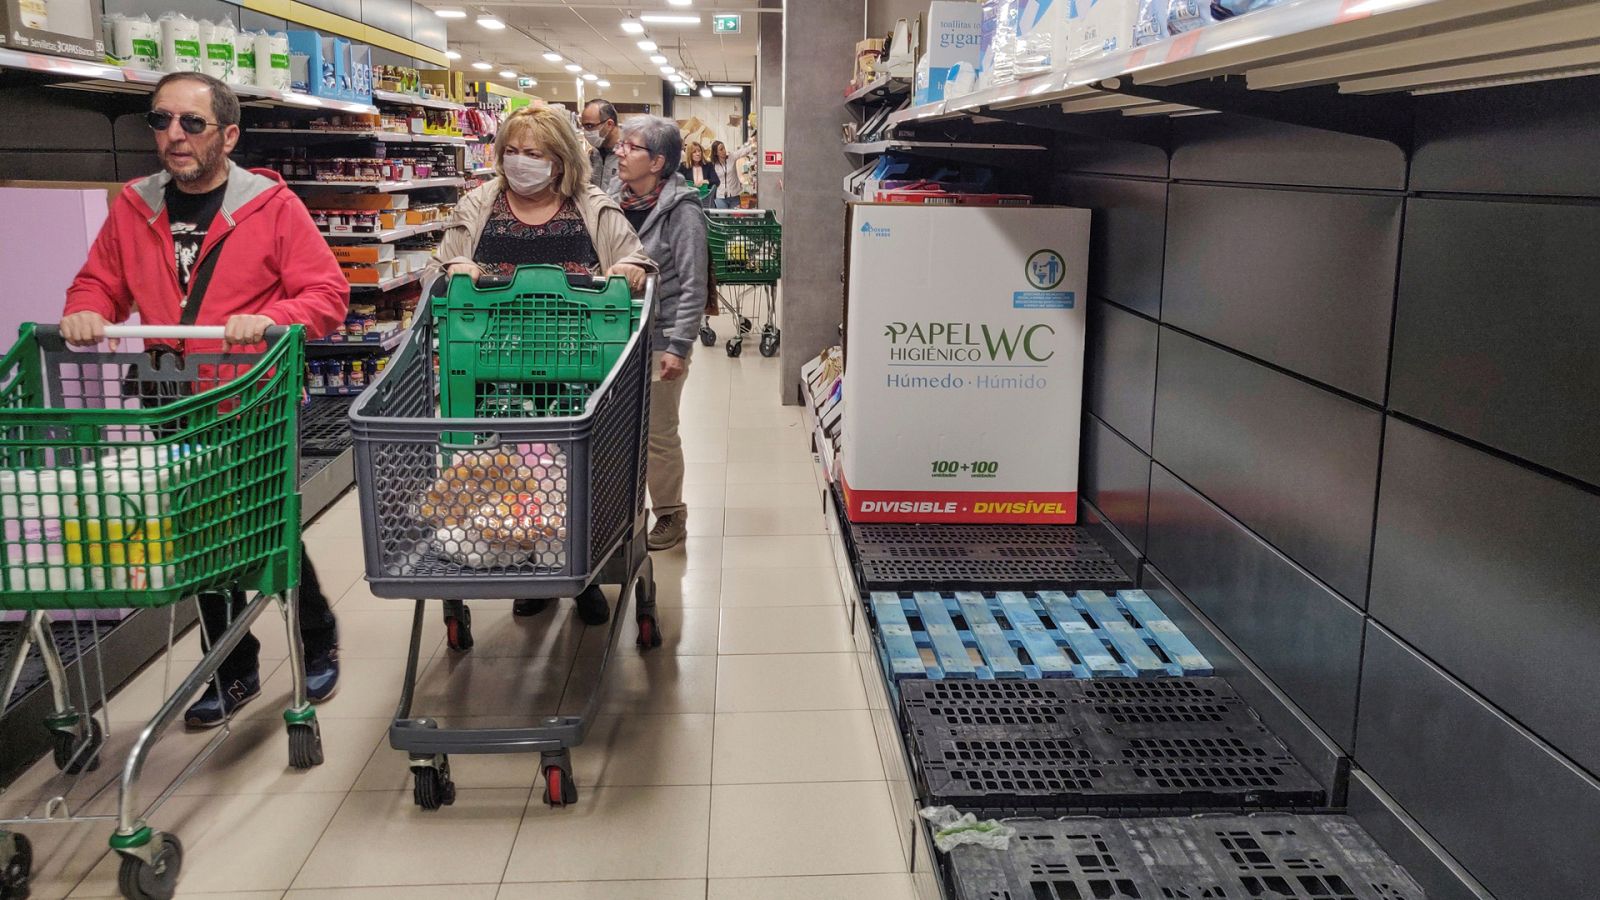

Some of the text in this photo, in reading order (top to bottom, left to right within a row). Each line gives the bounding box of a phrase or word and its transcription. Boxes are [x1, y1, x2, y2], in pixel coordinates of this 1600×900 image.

[884, 322, 1056, 362] PAPEL WC
[890, 346, 982, 362] HIGIÉNICO
[886, 373, 1048, 390] Húmedo Húmido
[860, 500, 1067, 514] DIVISIBLE DIVISÍVEL
